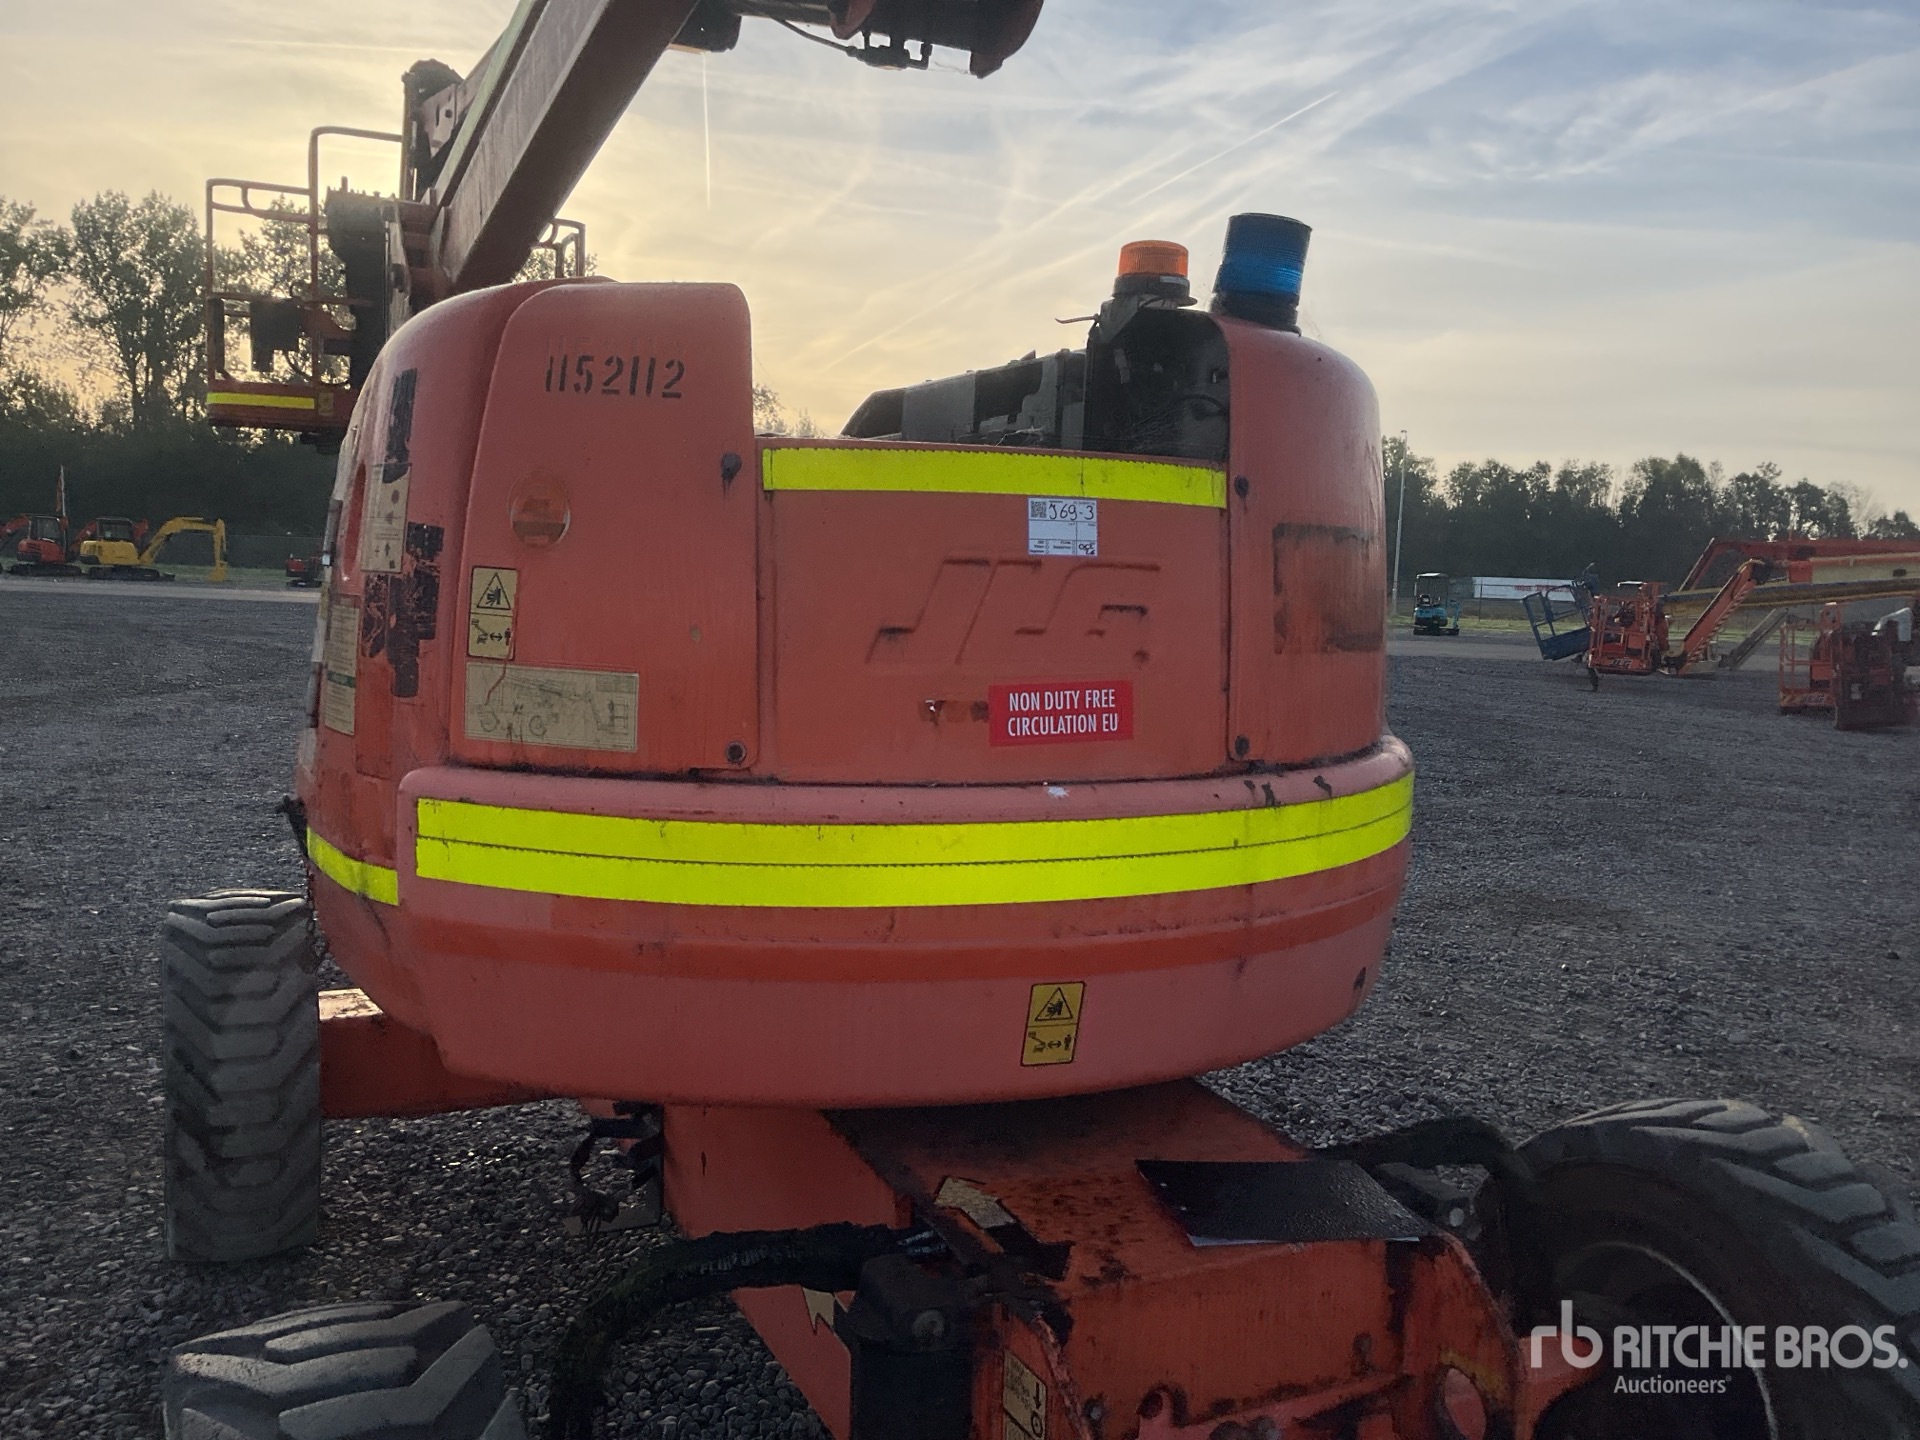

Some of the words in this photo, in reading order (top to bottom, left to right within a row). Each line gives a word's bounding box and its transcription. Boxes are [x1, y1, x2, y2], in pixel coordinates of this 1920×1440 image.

[545, 354, 685, 398] 1152112
[1009, 692, 1040, 712] NON
[1044, 690, 1080, 711] DUTY
[1085, 689, 1115, 709] FREE
[1008, 716, 1097, 737] CIRCULATION
[1102, 713, 1118, 732] EU
